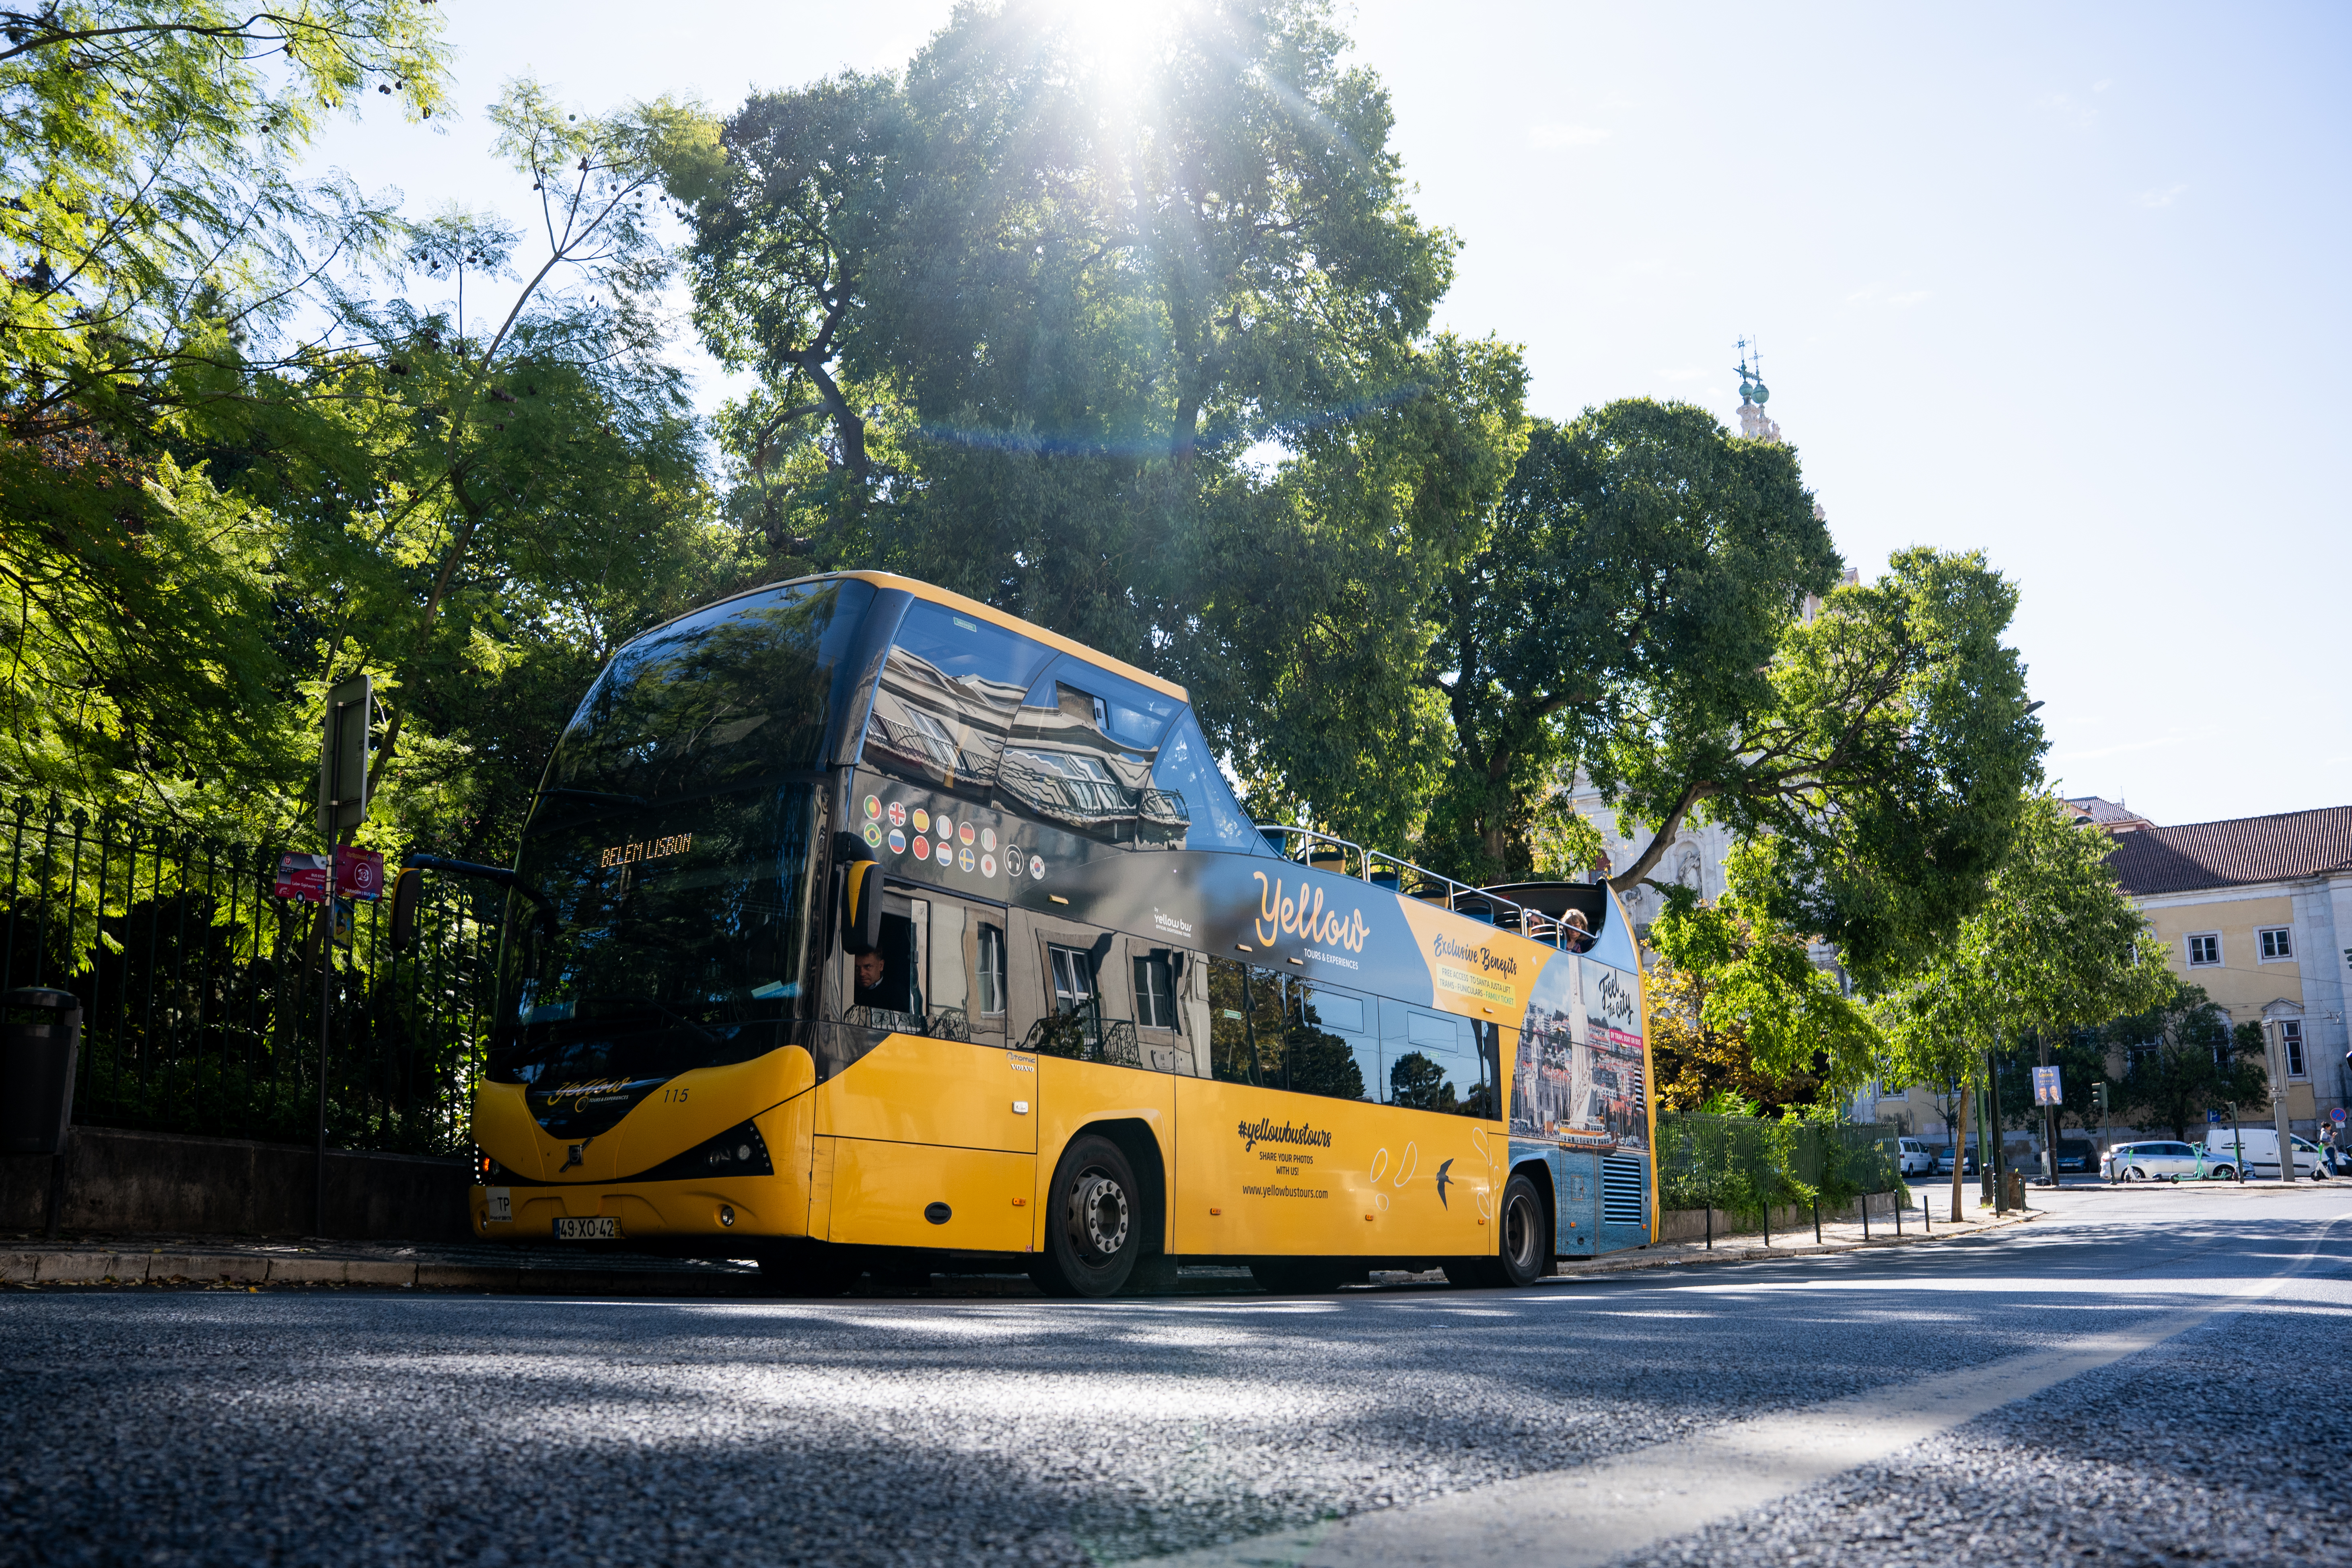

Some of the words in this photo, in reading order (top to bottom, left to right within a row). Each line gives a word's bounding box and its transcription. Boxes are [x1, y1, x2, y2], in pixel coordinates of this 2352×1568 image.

[601, 842, 643, 868] BELEM
[646, 833, 691, 859] LISBON
[1253, 871, 1370, 953] Yellow
[1180, 918, 1192, 932] bus
[1304, 948, 1321, 961] TOURS
[1322, 953, 1326, 962] &
[1327, 954, 1358, 970] EXPERIENCES
[1434, 933, 1478, 963] Exclusive
[1480, 947, 1517, 979] Benefits
[1442, 967, 1452, 977] FREE
[1453, 971, 1469, 982] ACCESS
[1470, 975, 1476, 984] TO
[1477, 977, 1490, 988] SANTA
[1490, 982, 1502, 992] JUSTA
[1599, 969, 1619, 1011] Feel
[1439, 978, 1454, 989] TRAMS
[1457, 984, 1483, 997] FUNICULARS
[1486, 991, 1500, 1001] FAMILY
[1500, 996, 1514, 1005] TICKET
[1607, 1002, 1615, 1018] the
[1616, 990, 1634, 1025] city
[1011, 1064, 1034, 1072] VOLVO
[664, 1089, 689, 1103] 115
[1238, 1117, 1332, 1152] #yellowbustours
[1259, 1151, 1277, 1161] SHARE
[1278, 1153, 1292, 1163] YOUR
[1293, 1154, 1313, 1164] PHOTOS
[1276, 1166, 1289, 1175] WITH
[1290, 1167, 1299, 1175] US!
[1243, 1184, 1328, 1199] www.yellowbustours.com
[497, 1197, 510, 1212] TP
